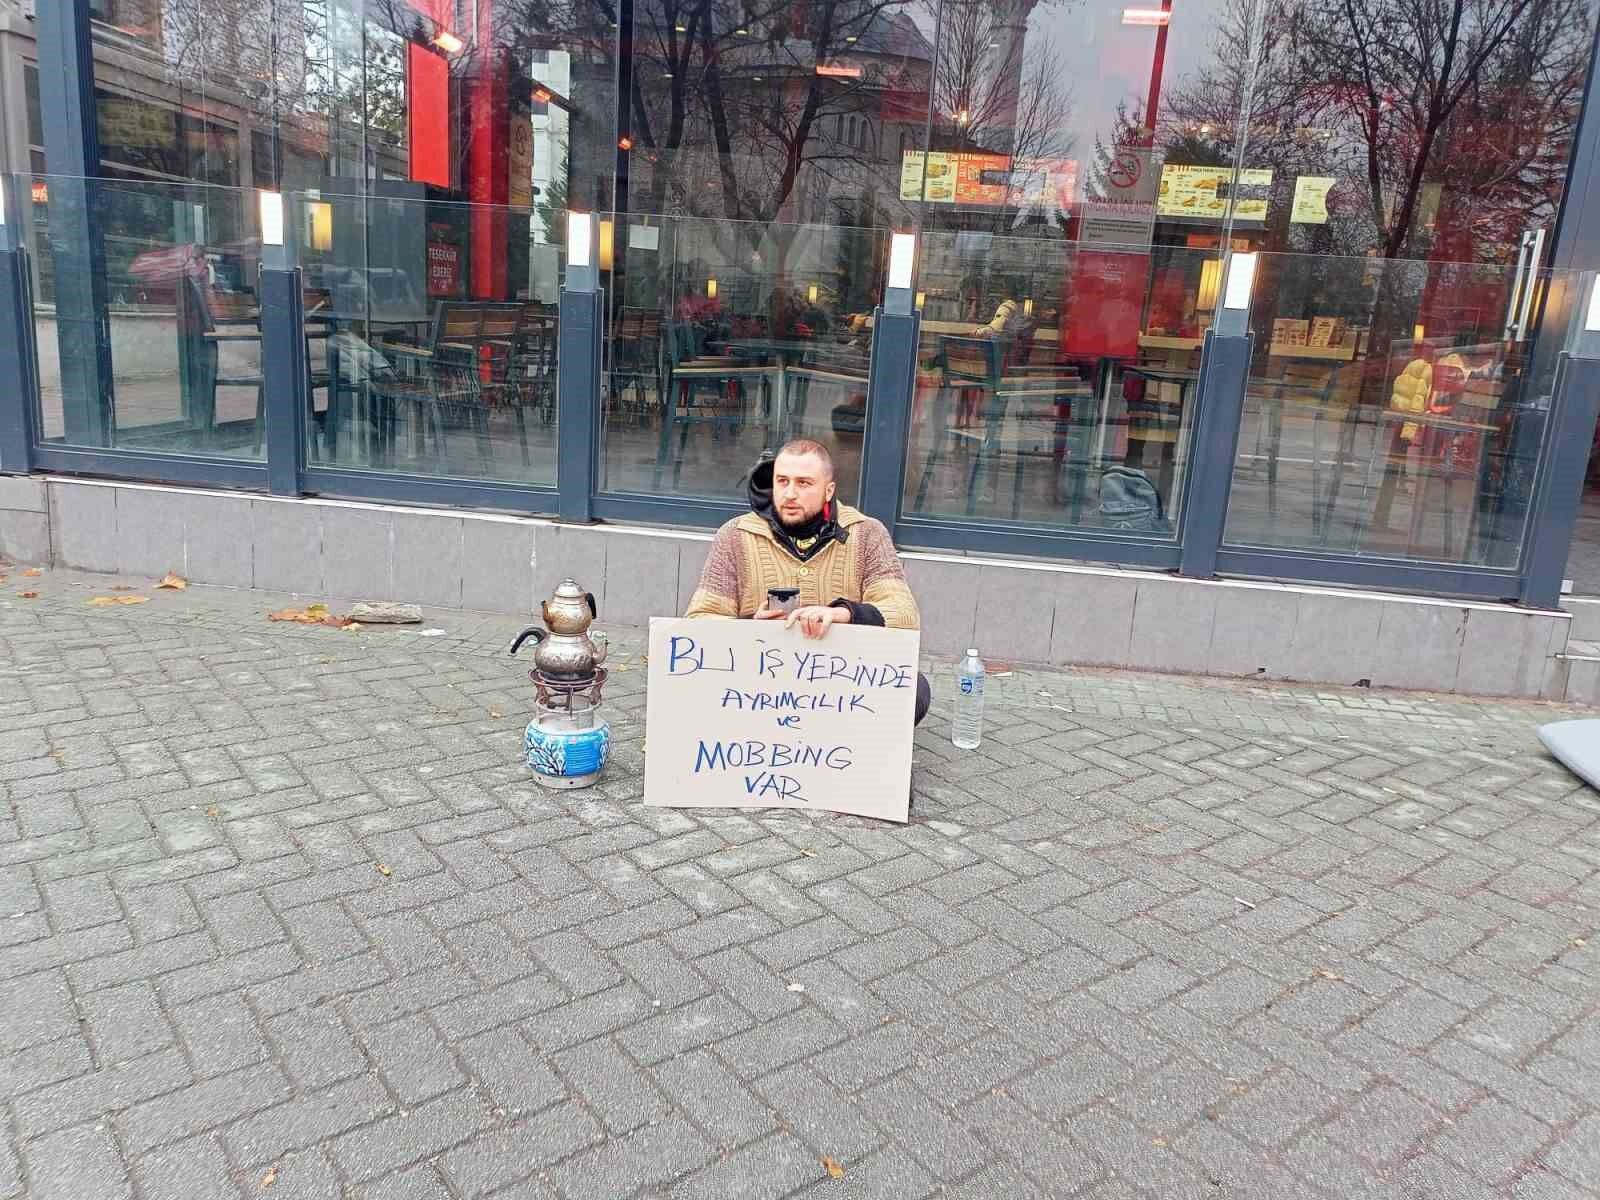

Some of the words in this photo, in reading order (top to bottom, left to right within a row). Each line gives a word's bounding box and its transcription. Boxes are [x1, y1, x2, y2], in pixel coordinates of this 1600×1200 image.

[667, 636, 735, 676] BU
[721, 688, 876, 714] AYRIMCILIK
[777, 715, 801, 729] ve
[744, 771, 809, 802] VAR
